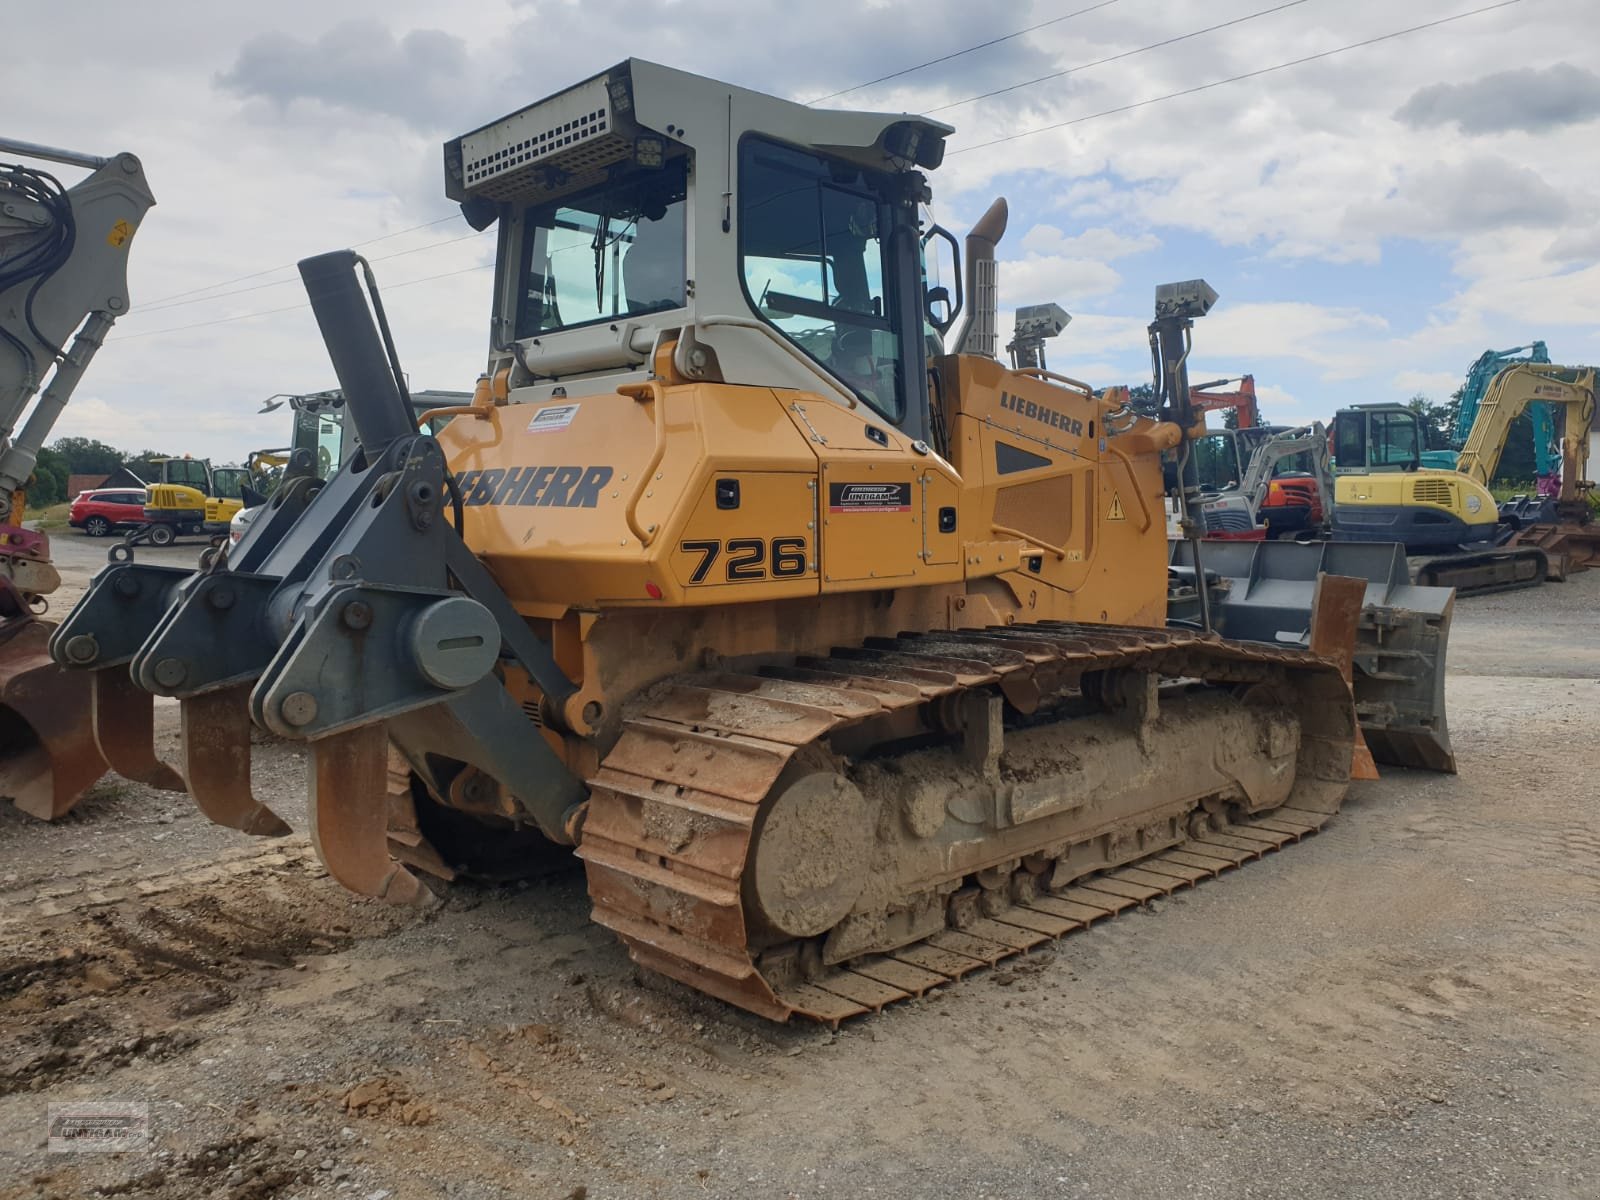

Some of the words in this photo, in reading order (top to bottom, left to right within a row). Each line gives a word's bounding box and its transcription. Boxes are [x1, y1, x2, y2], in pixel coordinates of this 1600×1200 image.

[1000, 391, 1083, 437] LIEBHERR
[442, 466, 613, 508] IEBHERR
[681, 536, 807, 584] 726
